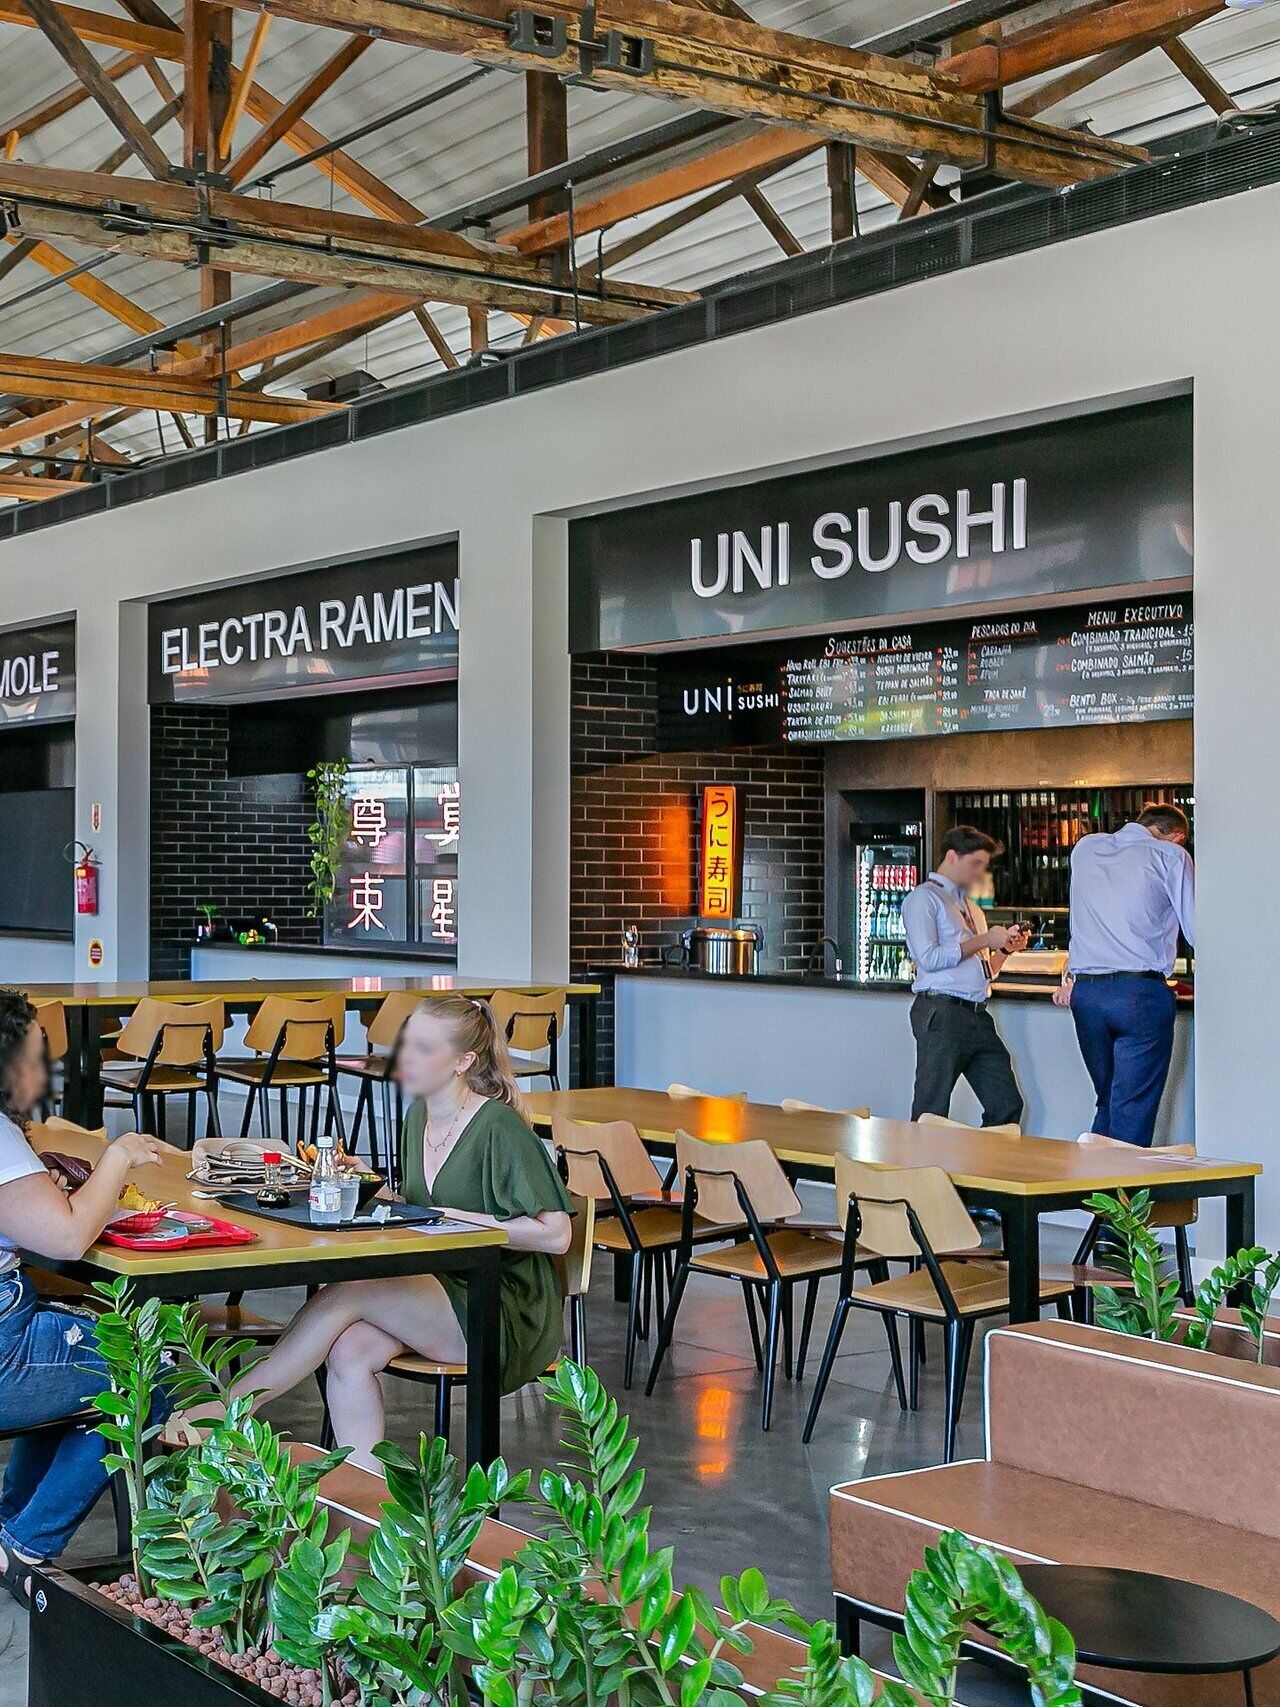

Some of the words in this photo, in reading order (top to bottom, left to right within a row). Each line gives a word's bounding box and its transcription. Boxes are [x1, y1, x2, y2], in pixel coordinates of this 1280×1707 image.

[691, 521, 790, 598] UNI
[811, 477, 1027, 580] SUSHI
[161, 605, 313, 675] ELECTRA
[320, 577, 461, 651] RAMEN
[1088, 610, 1117, 626] MENU
[1125, 604, 1183, 623] EXECUTIVO
[891, 635, 912, 651] CASA
[1071, 630, 1120, 647] COMBINADO
[1071, 657, 1118, 672] COMBINADO
[1122, 651, 1155, 668] SALMÃO
[683, 684, 733, 715] UNI
[738, 693, 779, 711] SUSHI
[1070, 693, 1096, 707] BENTO
[1101, 692, 1118, 705] BOX
[708, 792, 729, 913] うに寿司
